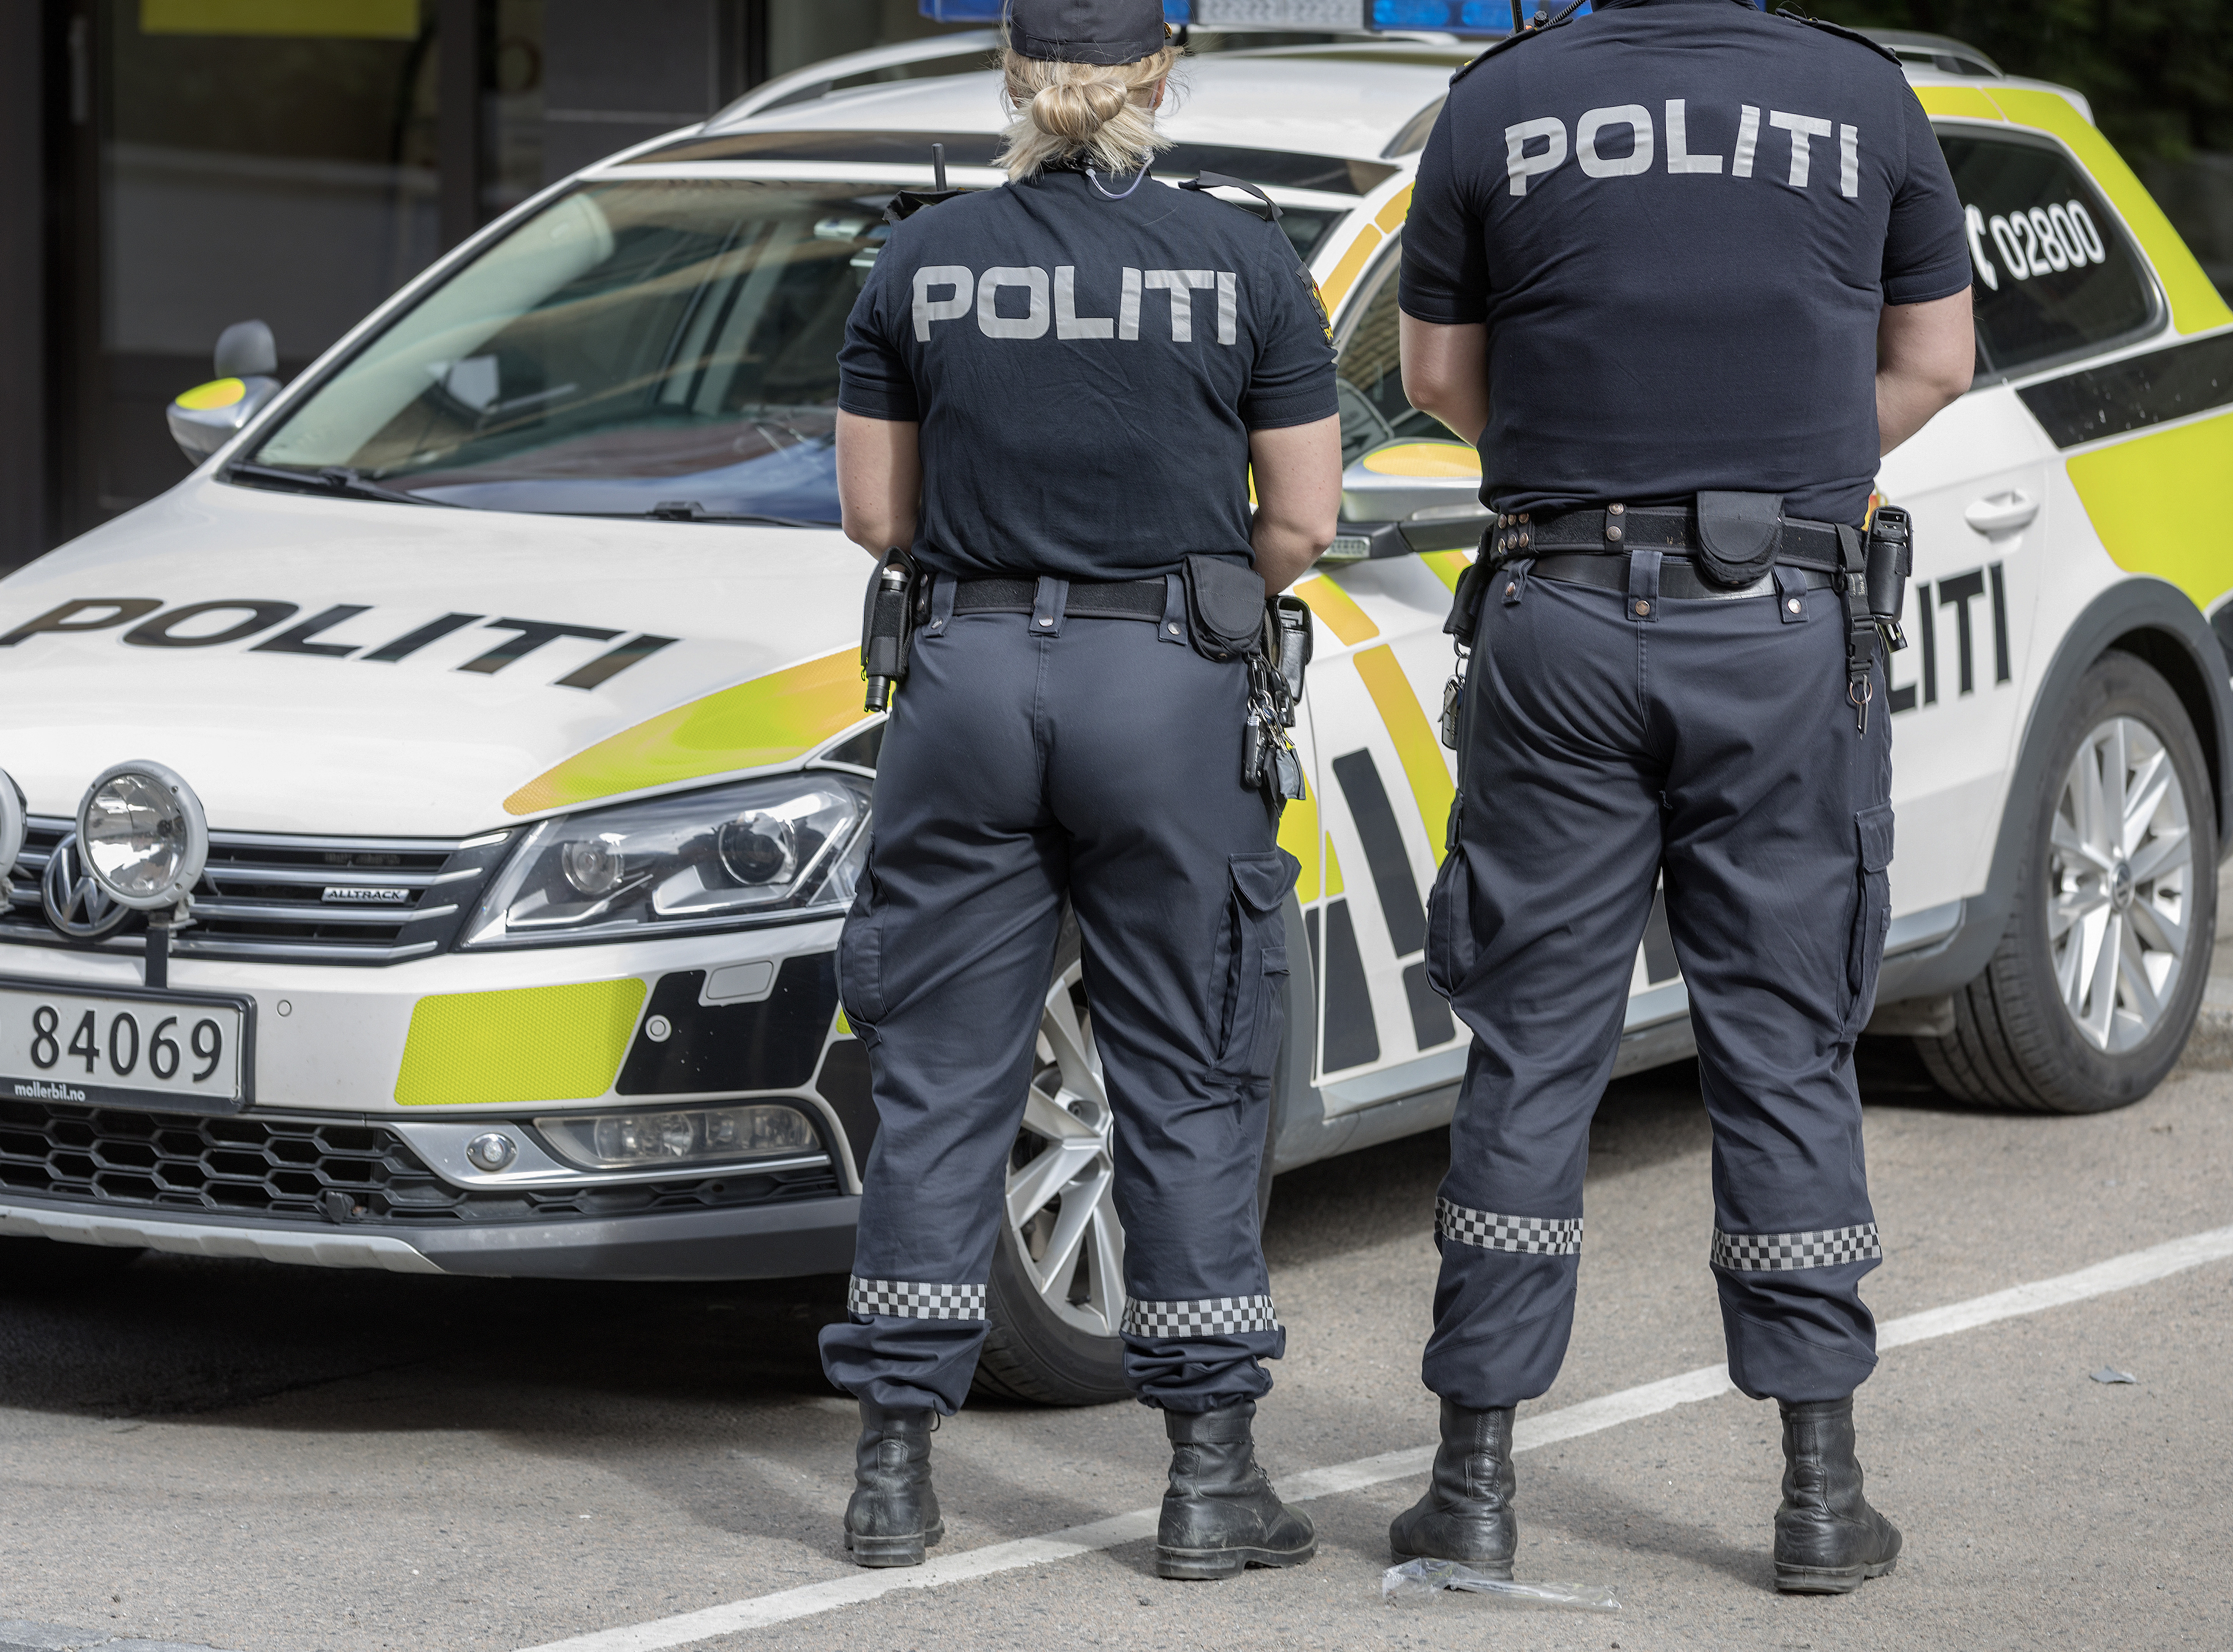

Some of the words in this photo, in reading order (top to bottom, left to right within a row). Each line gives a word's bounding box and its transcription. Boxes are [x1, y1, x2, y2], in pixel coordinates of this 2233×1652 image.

[1504, 99, 1859, 198] POLITI
[1989, 200, 2105, 281] 02800
[912, 265, 1237, 345] POLITI
[0, 597, 679, 690] POLITI
[1883, 562, 2010, 714] LITI
[328, 890, 400, 900] ALLTRACK
[31, 1005, 222, 1082] 84069
[14, 1081, 85, 1101] mollerbil.no
